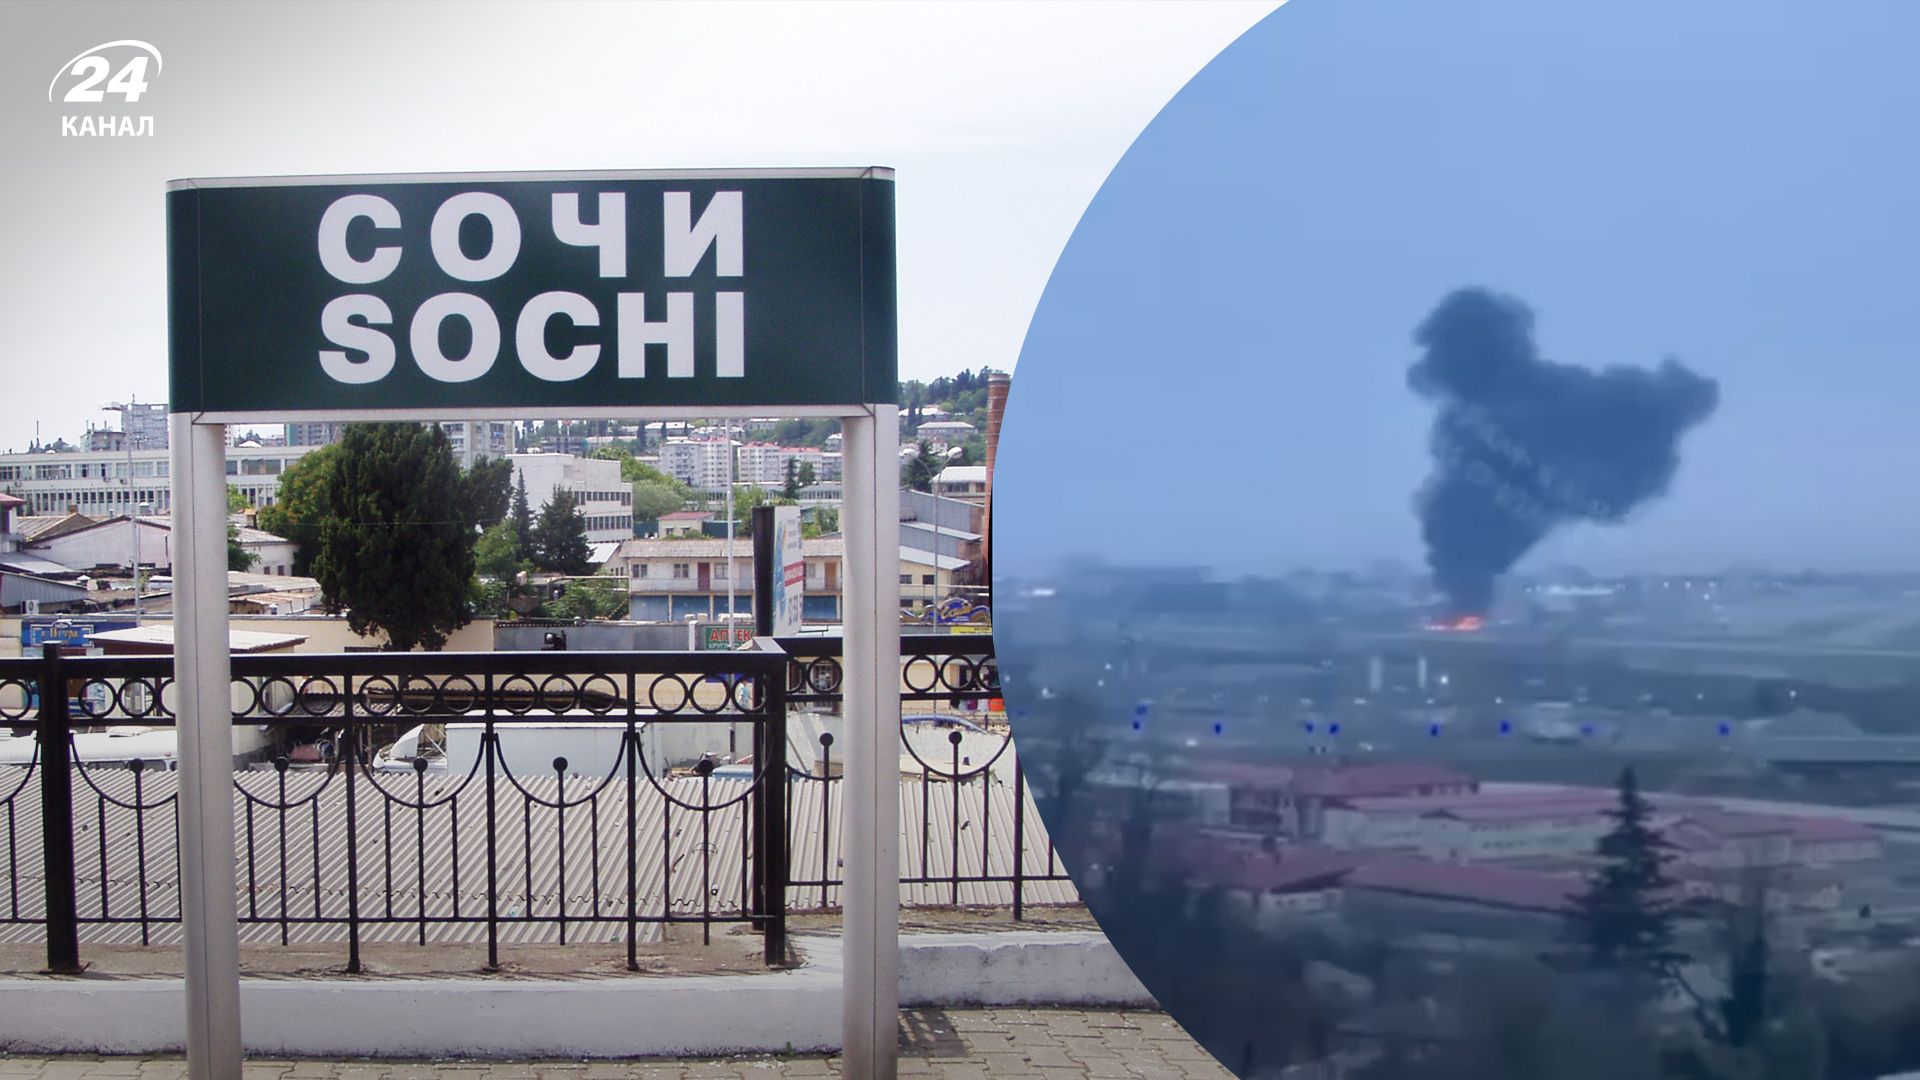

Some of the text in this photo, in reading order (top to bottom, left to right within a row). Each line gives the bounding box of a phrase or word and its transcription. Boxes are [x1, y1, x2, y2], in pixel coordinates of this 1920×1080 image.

[317, 191, 744, 285] СОЧИ
[318, 290, 745, 385] SOCHI
[710, 628, 757, 641] АПЕК
